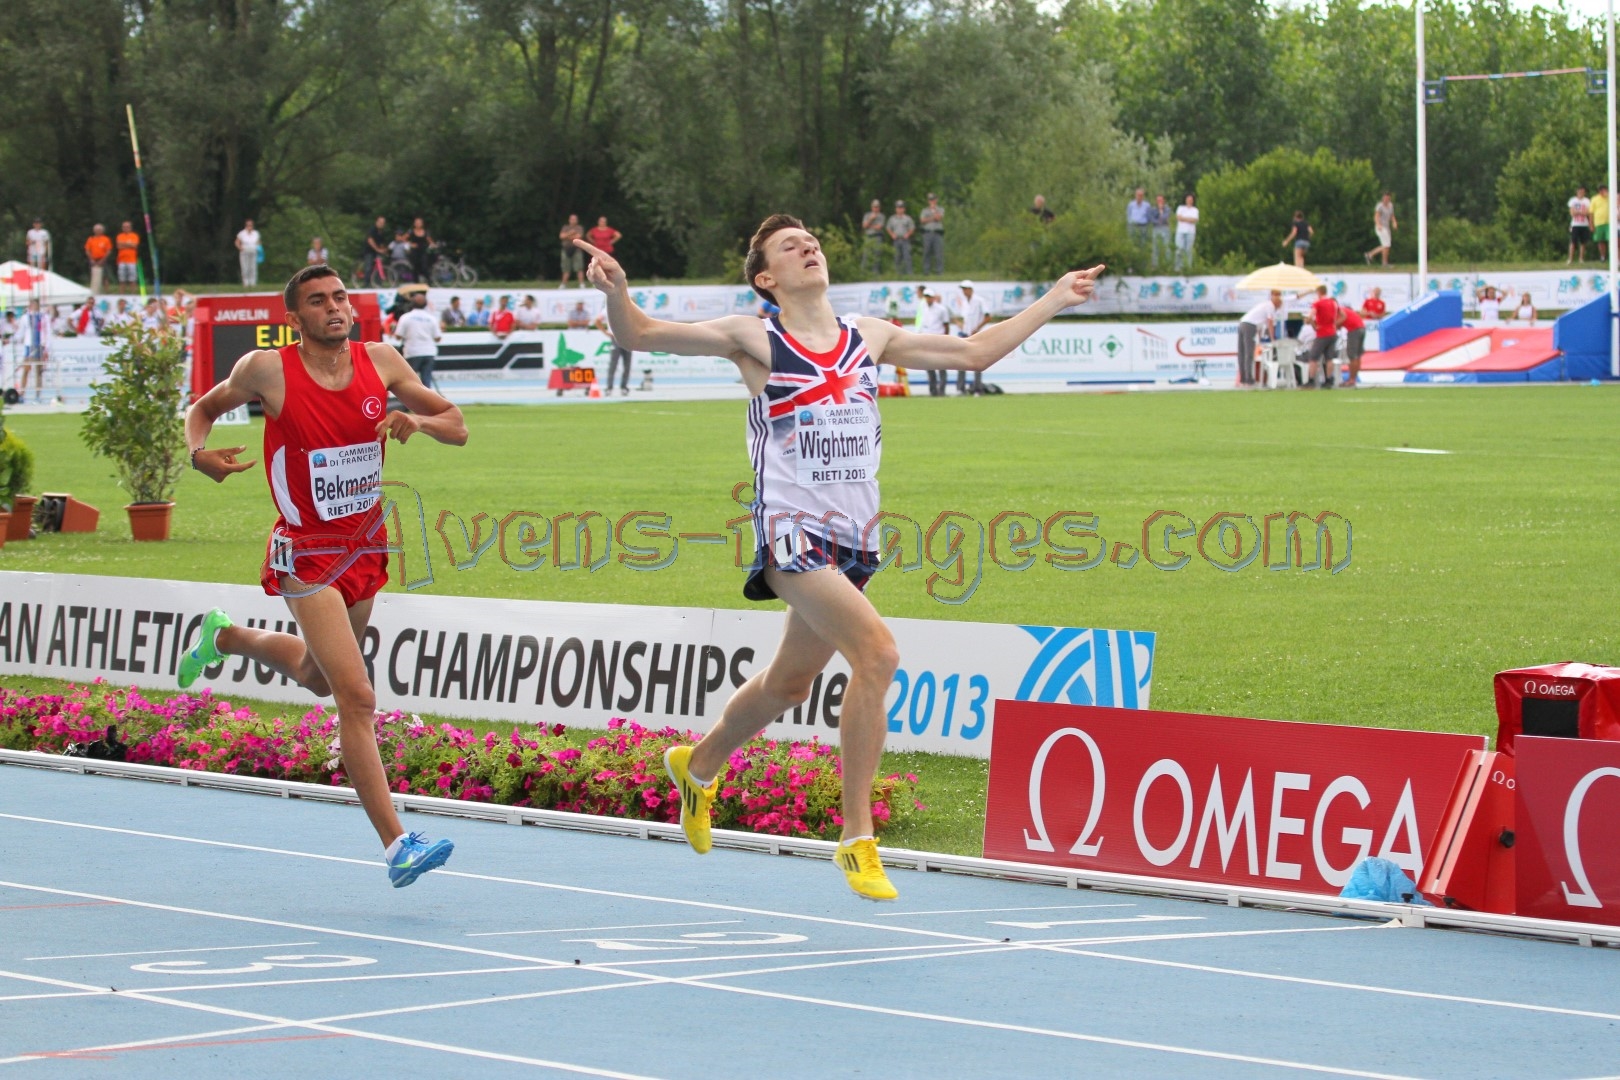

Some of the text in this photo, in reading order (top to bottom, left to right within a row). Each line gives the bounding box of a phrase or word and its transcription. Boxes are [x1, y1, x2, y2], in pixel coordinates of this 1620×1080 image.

[214, 309, 269, 321] JAVELIN
[1021, 338, 1092, 355] CARIRI
[1190, 337, 1216, 346] LAZIO
[825, 407, 864, 417] CAMMINO
[817, 416, 870, 426] DI FRANCESCO
[338, 445, 379, 458] CAMMINO
[799, 429, 870, 466] Wightman
[812, 469, 866, 481] RIETI 2013
[327, 503, 353, 517] RIETI
[889, 669, 989, 740] 2013
[1134, 759, 1424, 887] OMEGA
